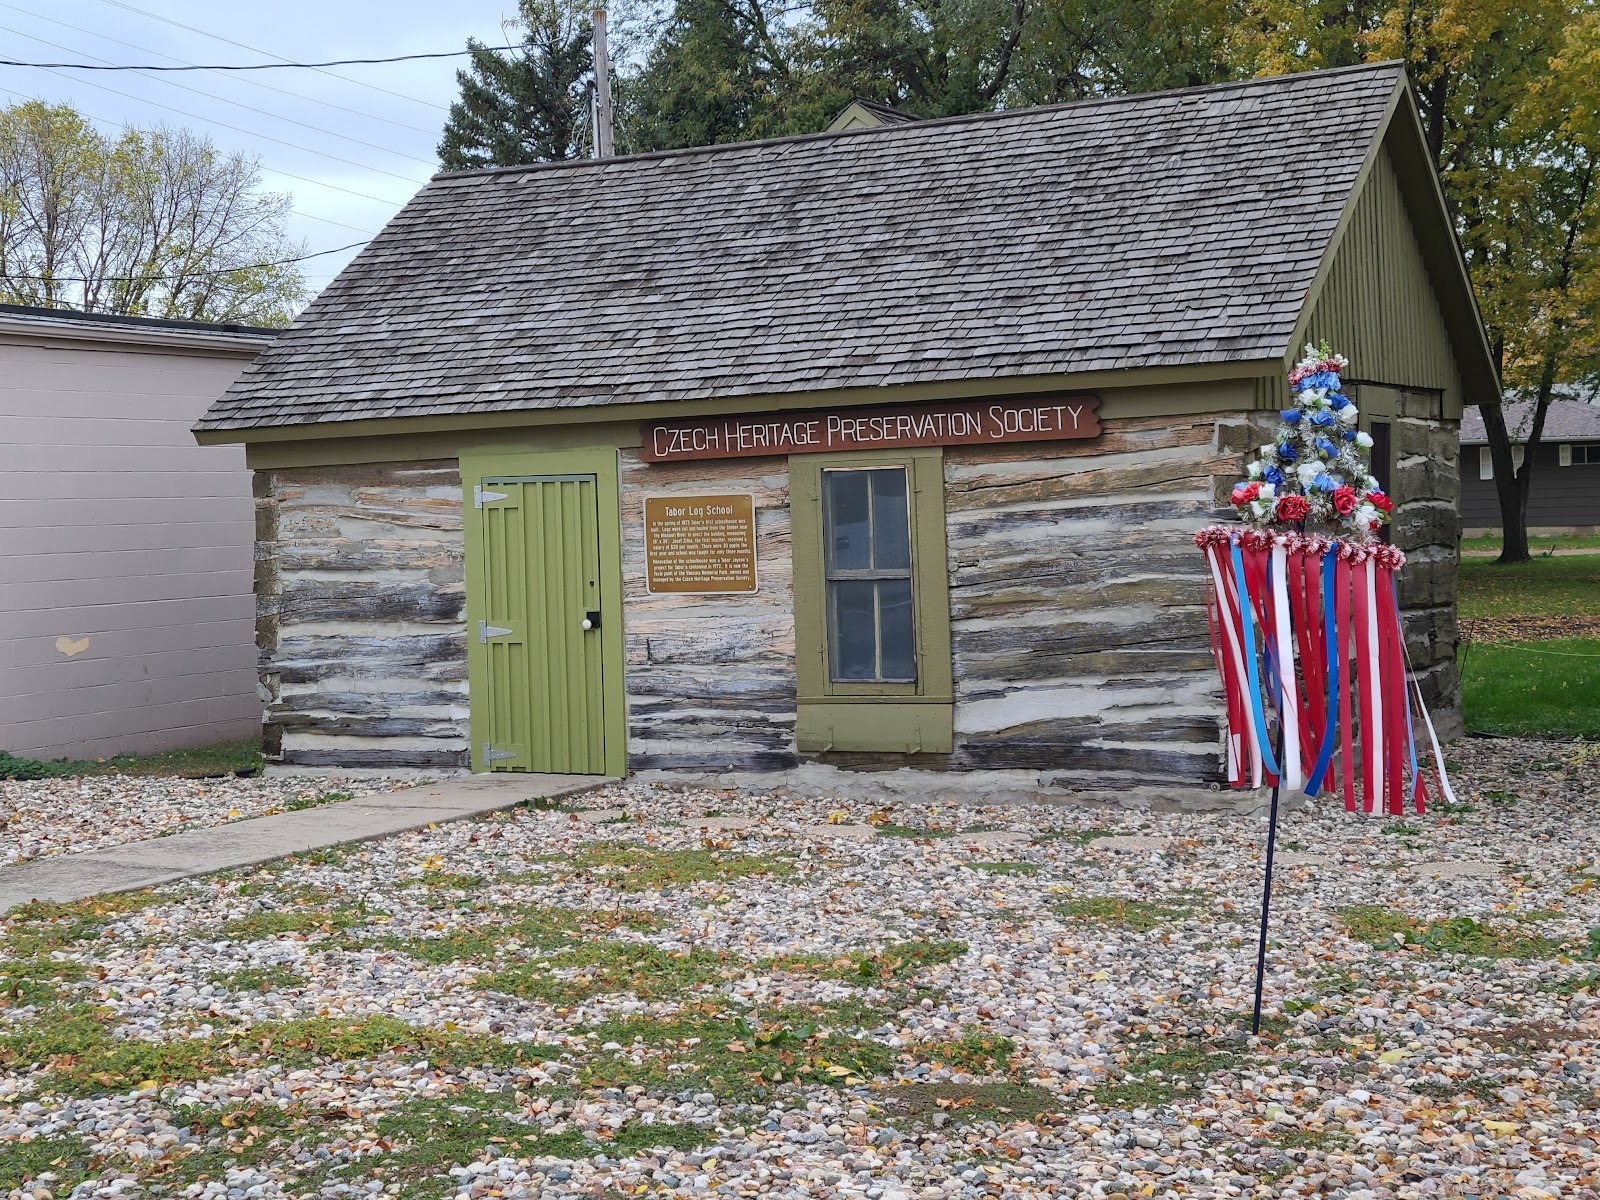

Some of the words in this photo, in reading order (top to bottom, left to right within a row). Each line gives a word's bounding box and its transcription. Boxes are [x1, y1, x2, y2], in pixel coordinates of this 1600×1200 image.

[653, 425, 719, 457] CZECH
[724, 420, 820, 452] HERITAGE
[827, 411, 982, 447] PRESERVATION
[989, 404, 1084, 439] SOCIETY
[665, 507, 685, 516] Tabor
[689, 506, 703, 518] Log
[707, 505, 732, 515] School
